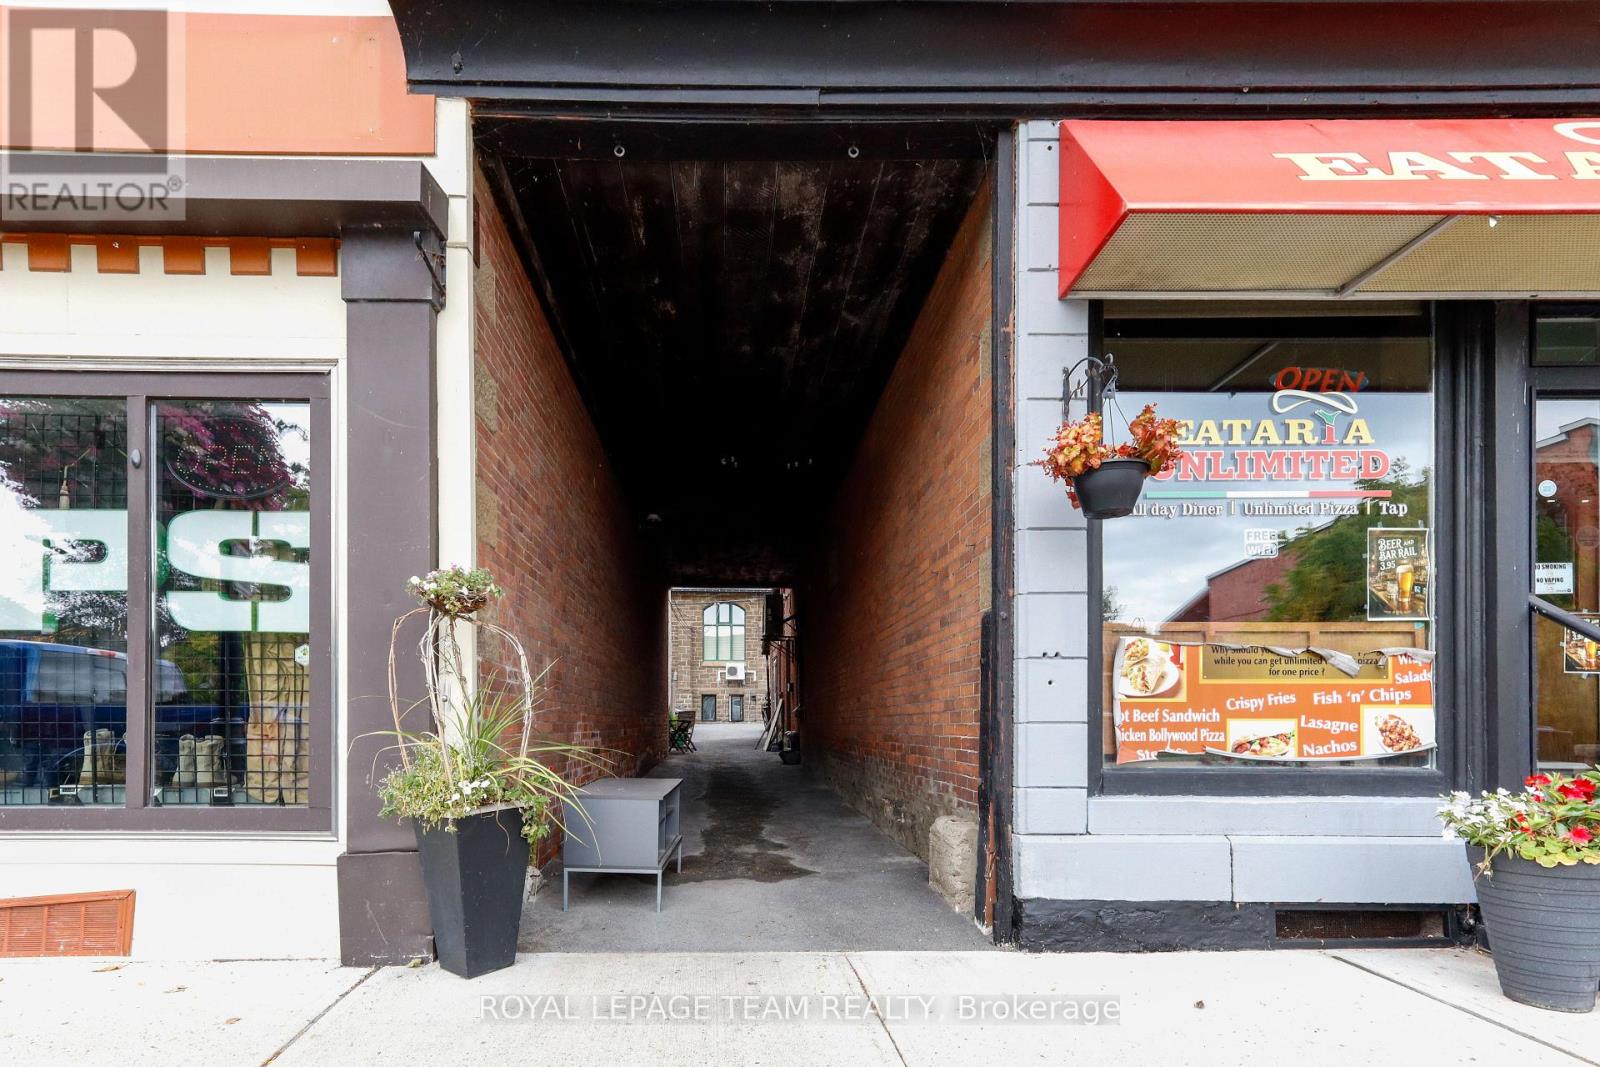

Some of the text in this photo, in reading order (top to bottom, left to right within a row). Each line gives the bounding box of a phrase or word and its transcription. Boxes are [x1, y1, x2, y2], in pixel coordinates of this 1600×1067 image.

[1275, 367, 1365, 392] OPEN
[1151, 503, 1177, 518] day
[1182, 503, 1223, 516] Diner
[1244, 502, 1313, 516] Unlimited
[1319, 502, 1359, 515] Pizza
[1379, 501, 1408, 517] Tap
[1246, 530, 1276, 541] FREE
[1378, 539, 1402, 551] BEER
[1379, 547, 1417, 561] BAR RAIL
[1380, 560, 1396, 570] 3.95
[1214, 656, 1236, 665] while
[1237, 658, 1252, 667] you
[1269, 657, 1282, 667] get
[1284, 656, 1322, 665] unlimited
[1299, 668, 1319, 678] price
[1226, 693, 1296, 712] Crispy Fries
[1313, 690, 1342, 704] Fish
[1369, 688, 1412, 704] Chips
[1133, 708, 1159, 722] Beef
[1162, 708, 1220, 722] Sandwich
[1300, 715, 1358, 734] Lasagne
[1149, 728, 1198, 744] Bollywood
[1200, 728, 1225, 742] Pizza
[1303, 740, 1358, 756] Nachos
